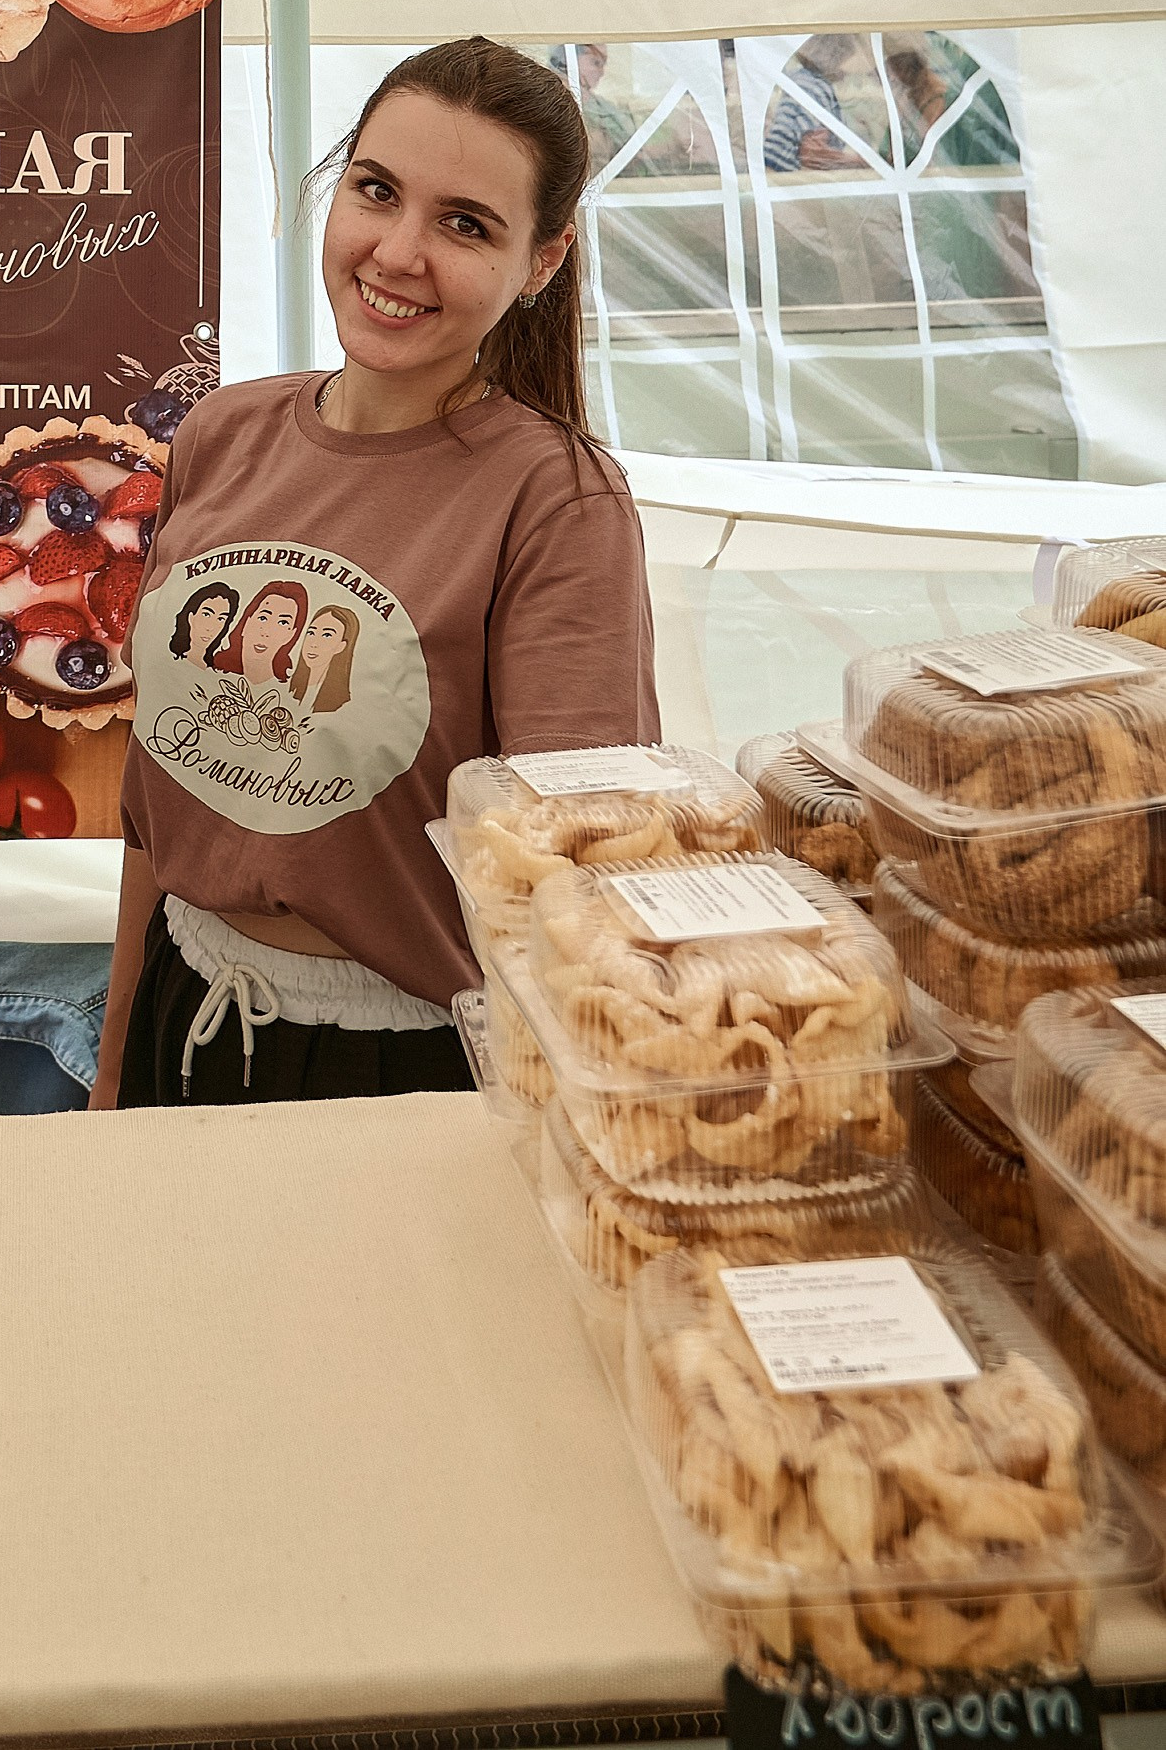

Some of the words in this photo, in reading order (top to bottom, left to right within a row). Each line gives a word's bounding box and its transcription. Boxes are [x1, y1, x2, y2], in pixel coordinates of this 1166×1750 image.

[185, 549, 333, 580] КУЛИНАРНАЯ
[331, 566, 396, 621] ЛАВКА
[147, 707, 355, 806] Романовых
